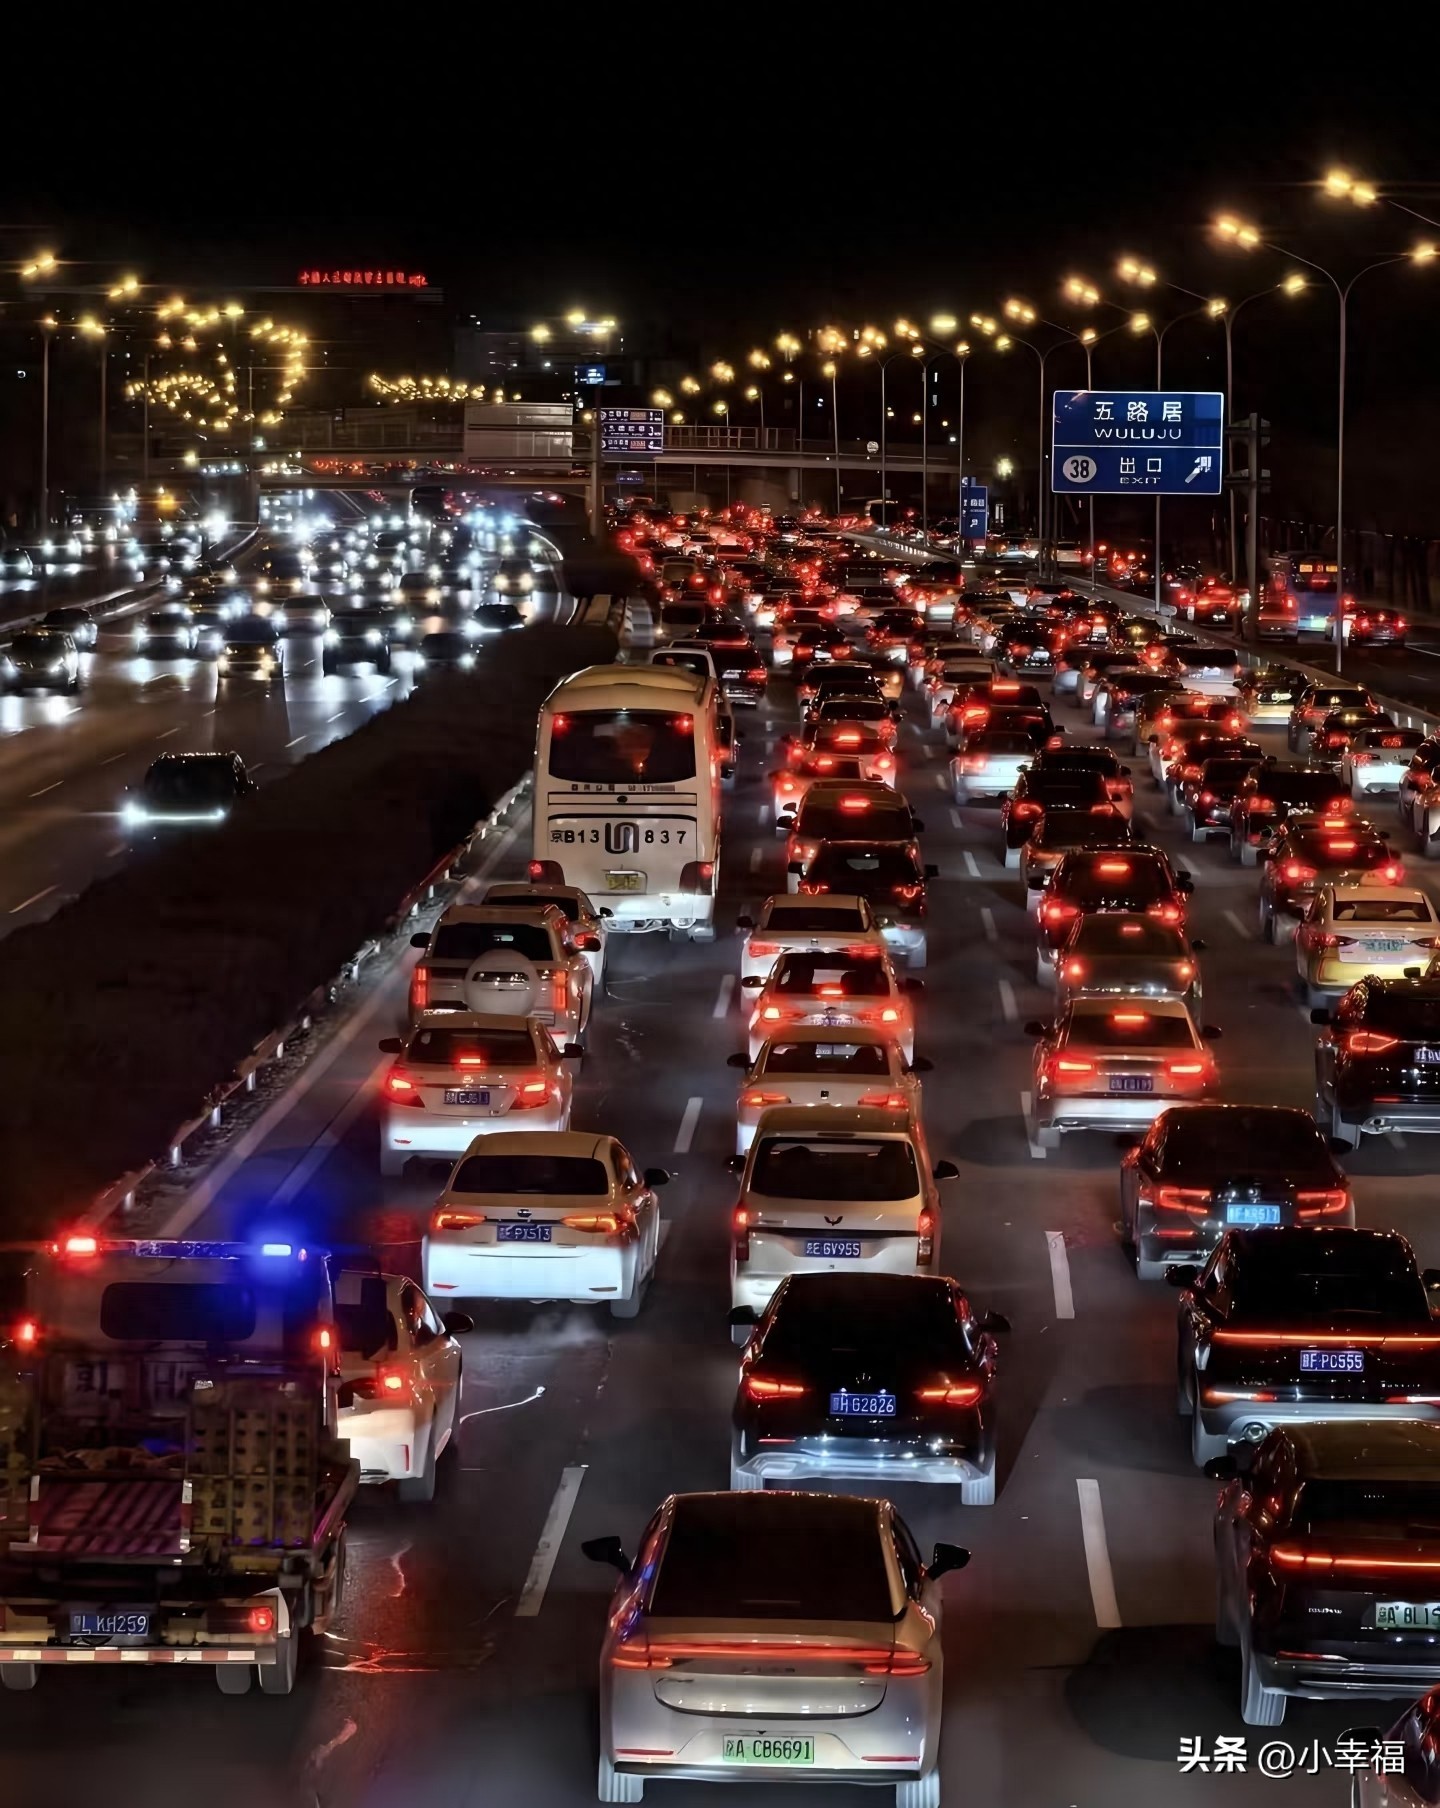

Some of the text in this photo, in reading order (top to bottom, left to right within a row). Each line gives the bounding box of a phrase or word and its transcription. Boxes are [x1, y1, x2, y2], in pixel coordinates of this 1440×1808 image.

[1093, 401, 1183, 423] 五路居
[1094, 428, 1182, 440] WULUJU
[1069, 459, 1090, 479] 38
[1119, 456, 1162, 474] 出口
[644, 829, 687, 845] 837
